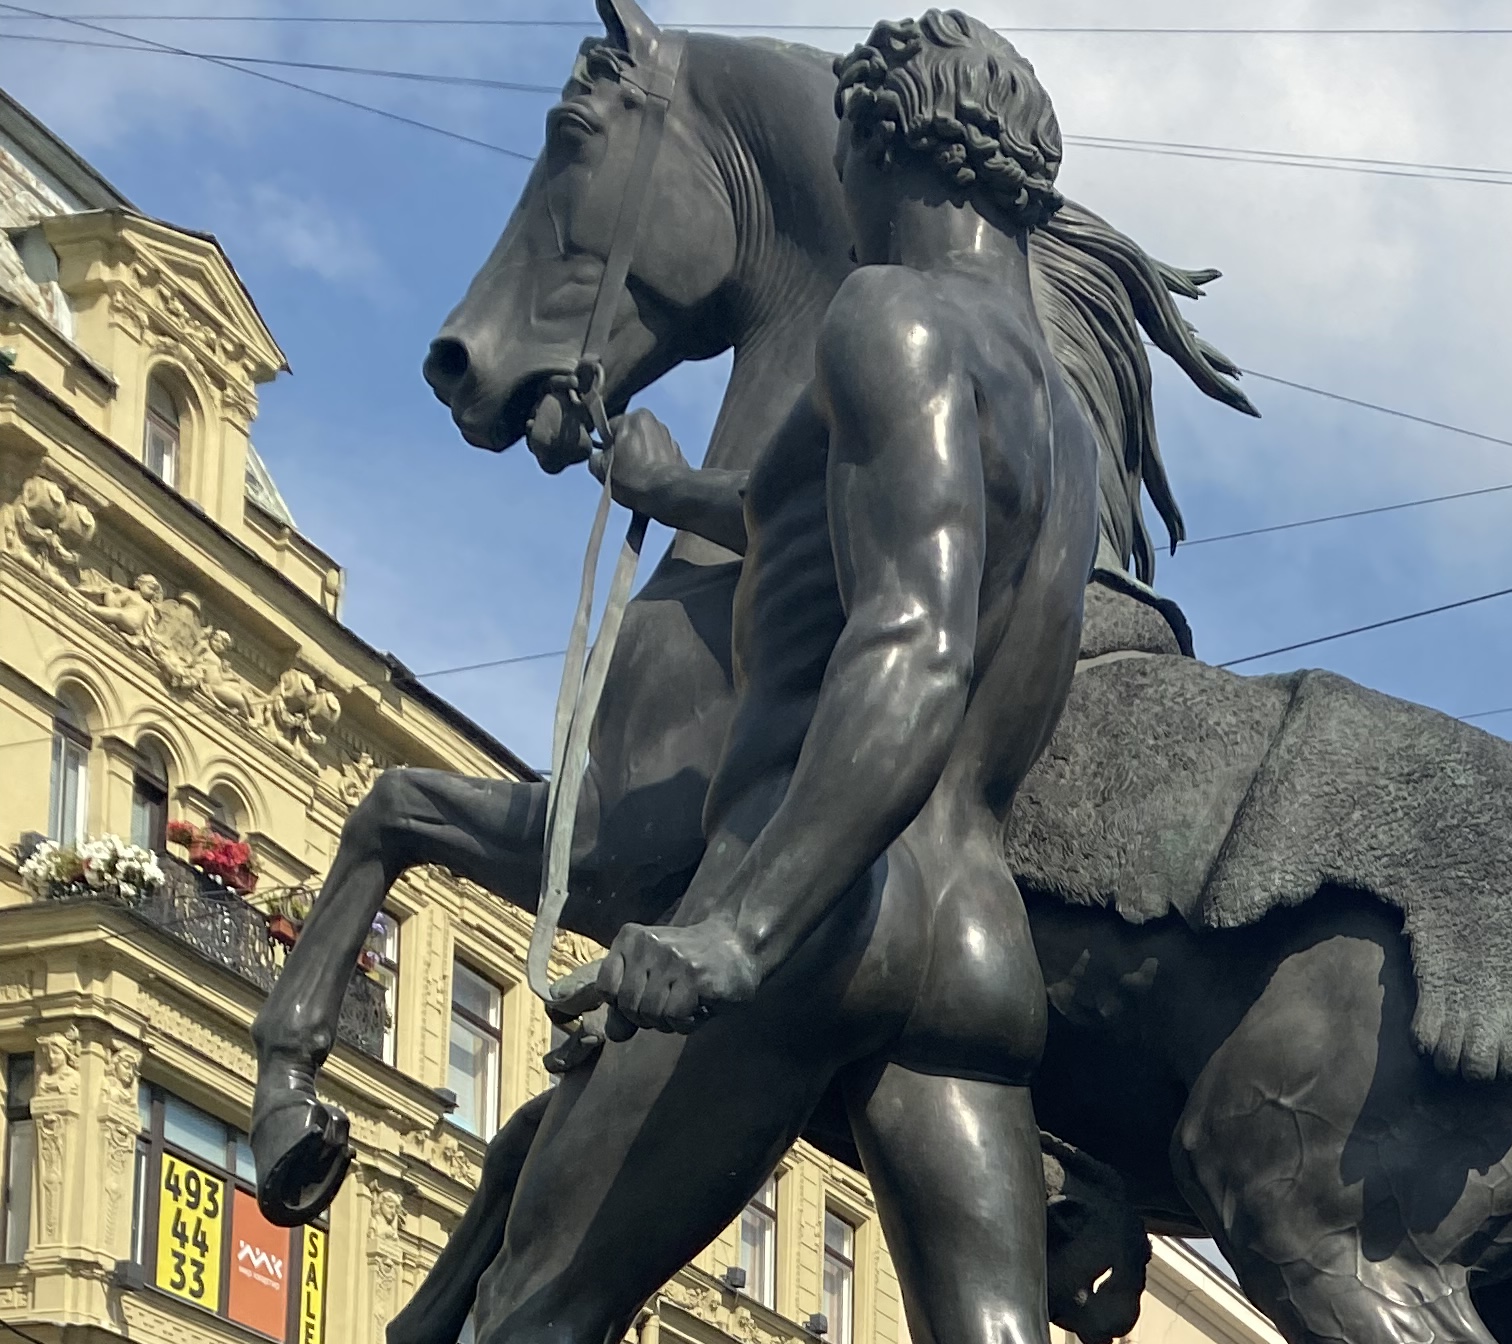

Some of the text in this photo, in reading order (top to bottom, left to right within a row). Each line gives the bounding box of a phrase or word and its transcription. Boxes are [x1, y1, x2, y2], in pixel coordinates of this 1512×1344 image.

[164, 1160, 219, 1219] 493
[171, 1207, 209, 1258] 44
[169, 1248, 206, 1299] 33
